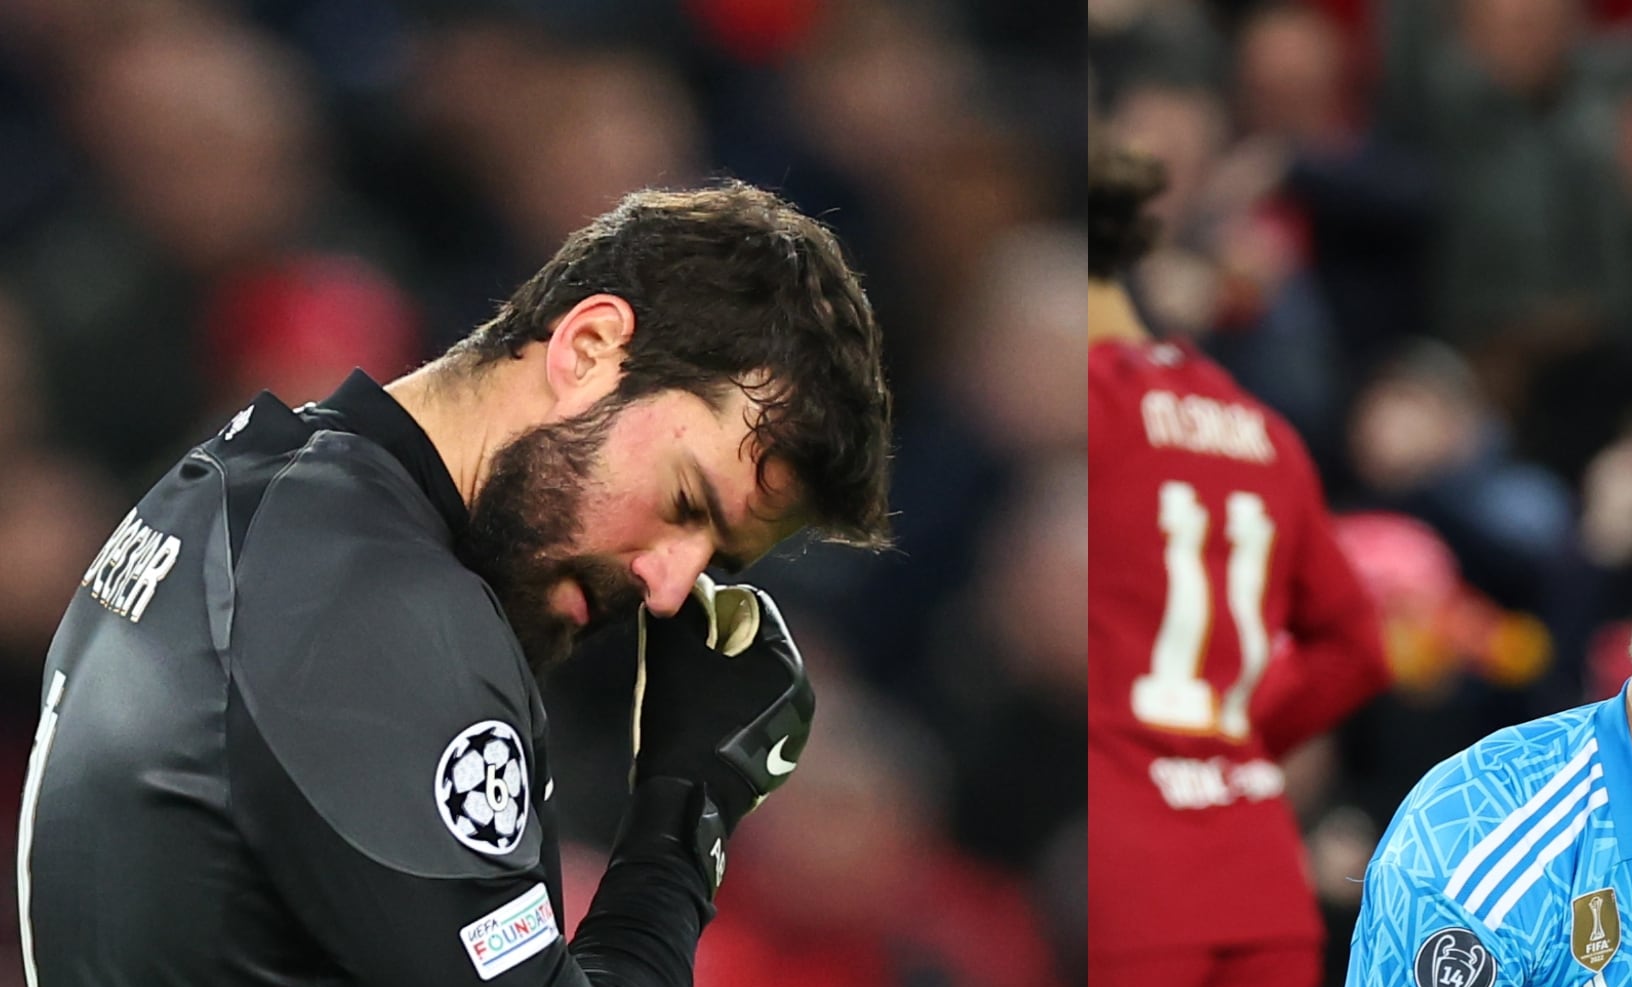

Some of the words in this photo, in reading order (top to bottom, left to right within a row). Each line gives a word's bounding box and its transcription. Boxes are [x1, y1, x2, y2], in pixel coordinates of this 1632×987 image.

[1131, 480, 1276, 742] 11
[486, 763, 509, 812] 6
[468, 918, 499, 942] UEFA
[1586, 940, 1610, 954] FIFA
[1440, 966, 1464, 987] 14
